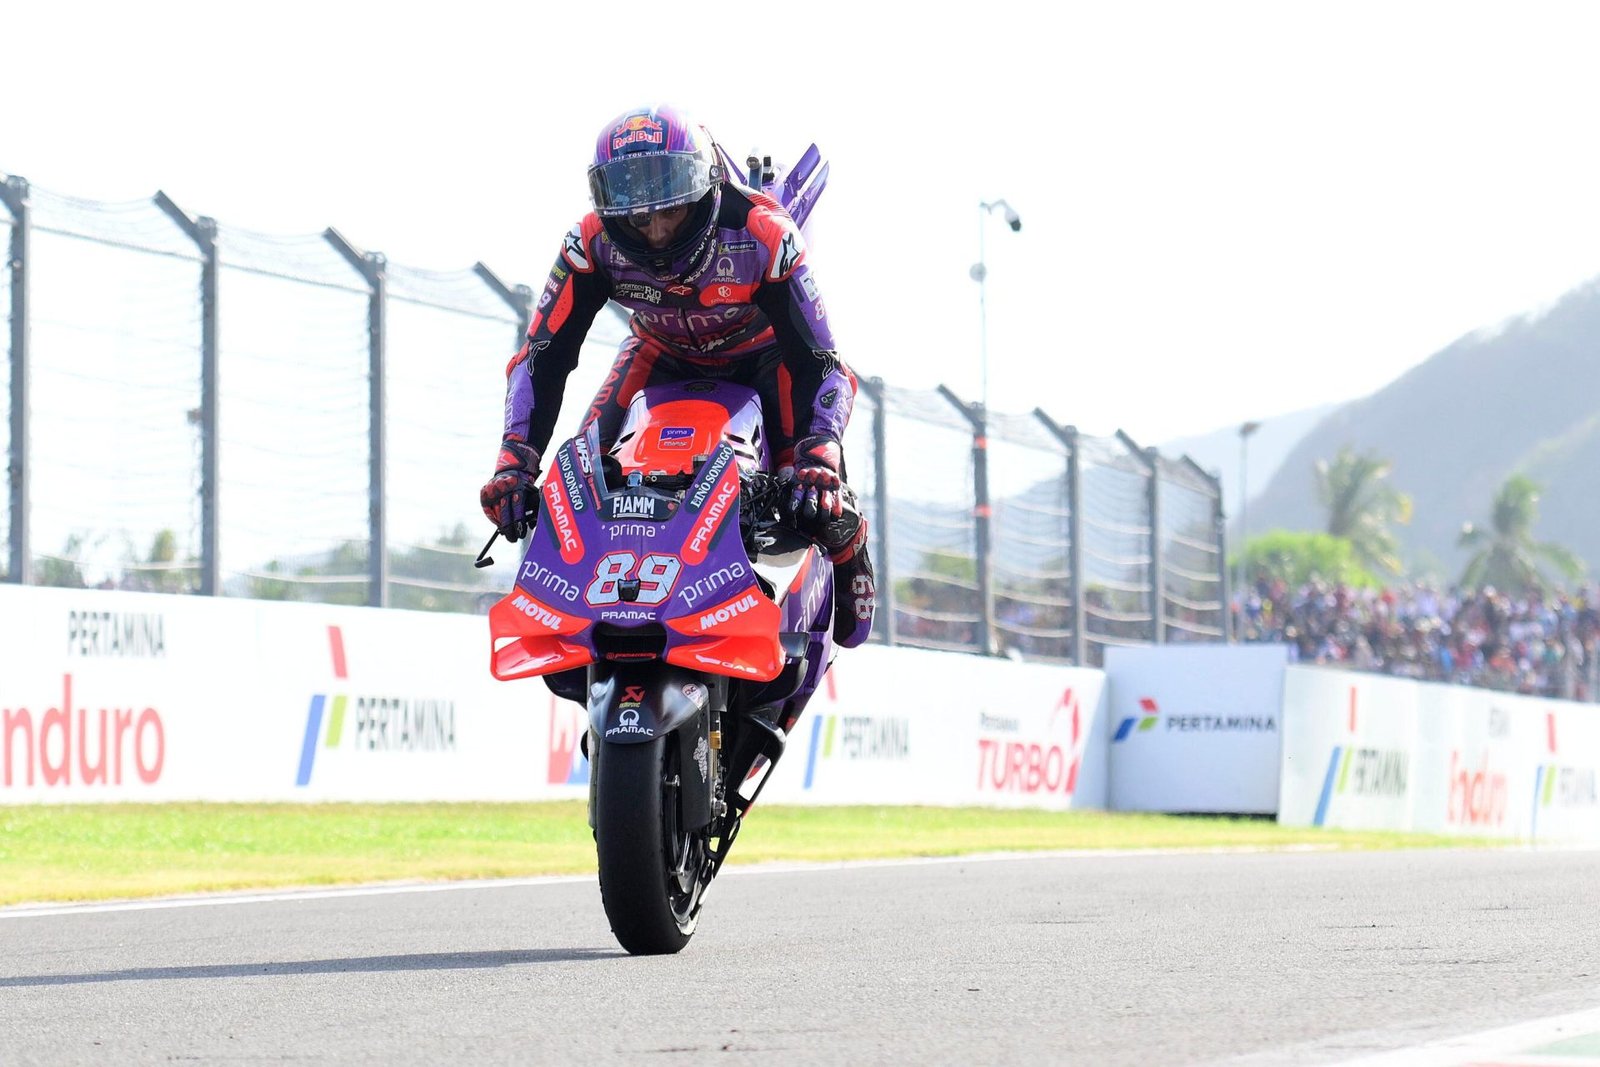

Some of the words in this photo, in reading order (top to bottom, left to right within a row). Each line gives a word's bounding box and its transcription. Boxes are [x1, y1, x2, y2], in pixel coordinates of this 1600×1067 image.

[613, 131, 635, 149] Red
[636, 130, 662, 143] Bull
[630, 291, 662, 305] HELMET
[558, 448, 572, 472] LINO
[574, 437, 593, 474] WRS
[564, 469, 583, 512] SONEGO
[690, 480, 712, 508] LINO
[704, 446, 733, 487] SONEGO
[546, 481, 579, 552] PRAMAC
[613, 496, 655, 514] FIAMM
[689, 483, 736, 553] PRAMAC
[609, 523, 656, 541] prima
[522, 560, 580, 602] prima
[586, 551, 683, 606] 89
[678, 561, 745, 608] prima
[511, 594, 561, 631] MOTUL
[601, 611, 656, 621] PRAMAC
[701, 594, 760, 630] MOTUL
[67, 610, 166, 657] PERTAMINA
[355, 695, 457, 752] PERTAMINA
[605, 726, 654, 738] PRAMAC
[1167, 715, 1276, 733] PERTAMINA
[977, 739, 1064, 794] TURBO
